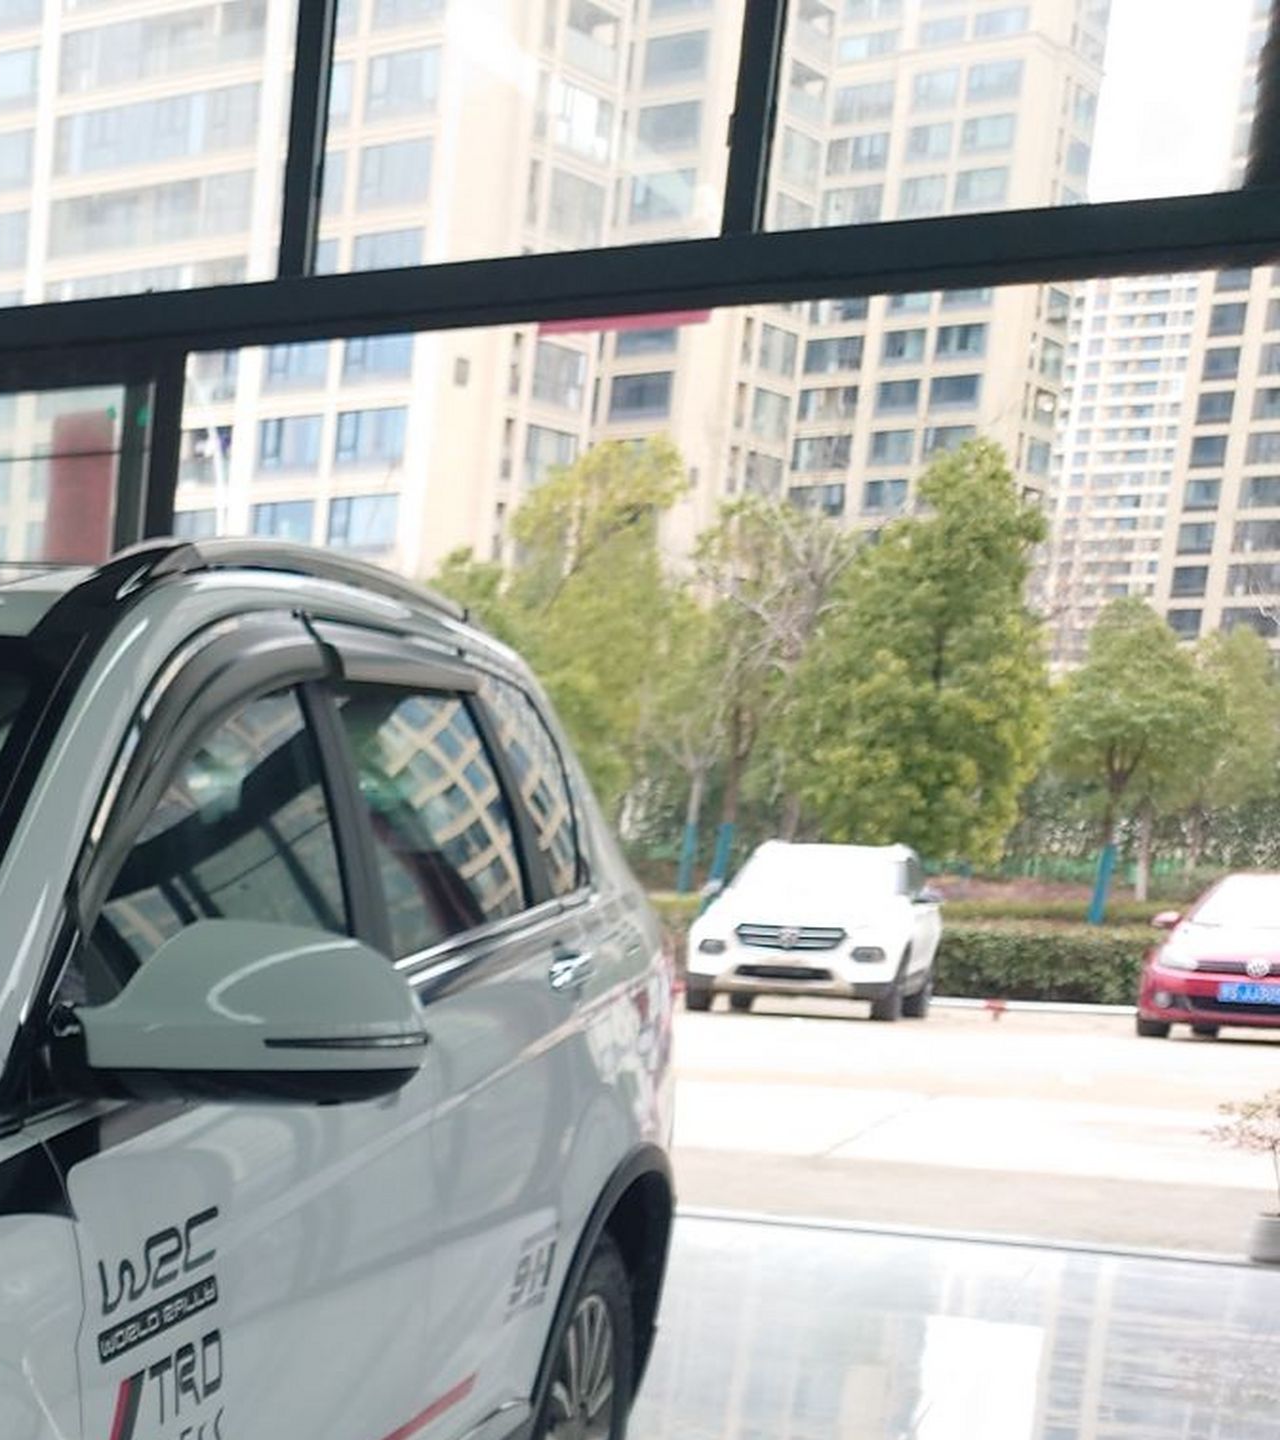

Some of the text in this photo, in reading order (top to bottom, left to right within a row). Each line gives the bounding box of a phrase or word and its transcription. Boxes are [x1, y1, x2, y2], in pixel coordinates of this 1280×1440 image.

[98, 1206, 219, 1316] WRC
[100, 1310, 162, 1357] WORLD
[149, 1328, 223, 1425] TRD
